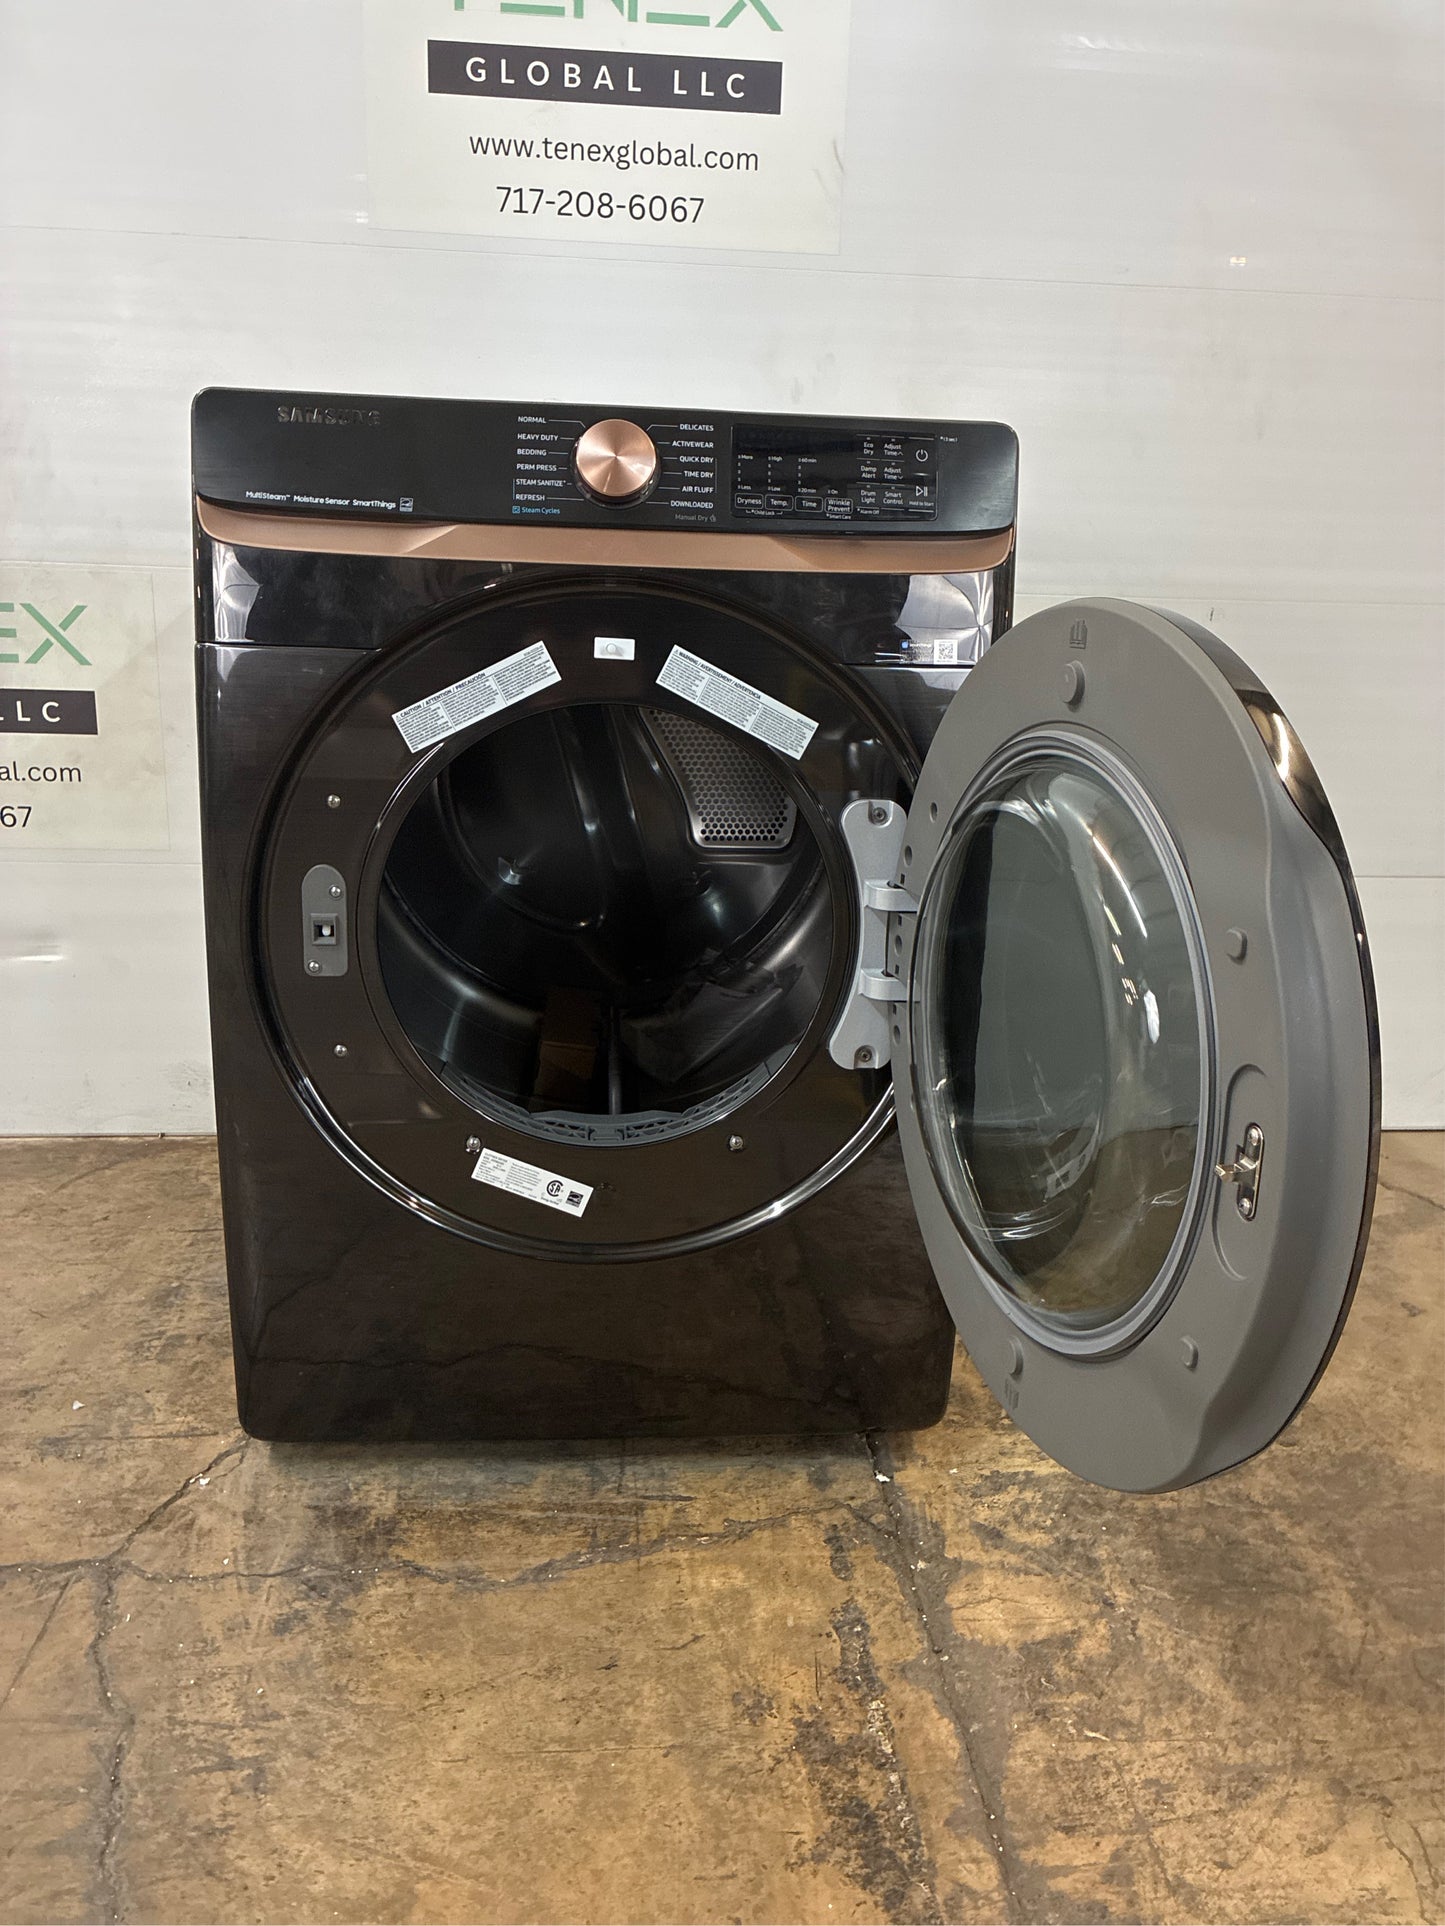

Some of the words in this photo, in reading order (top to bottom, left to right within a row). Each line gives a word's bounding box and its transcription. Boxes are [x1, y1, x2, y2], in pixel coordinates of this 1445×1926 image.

[465, 56, 642, 93] GLOBAL
[672, 69, 746, 99] LLC
[469, 136, 759, 171] www.tenexglobal.com
[496, 186, 705, 223] 717-208-6067
[672, 440, 714, 448] ACTIVEWEAR
[516, 448, 547, 456] BEDDING
[516, 463, 536, 471] PERM
[515, 478, 537, 486] STEAM
[293, 495, 325, 504] Moisture
[325, 497, 350, 505] Sensor
[352, 500, 396, 510] SmartThings
[670, 501, 714, 509] DOWNLOADED
[737, 497, 762, 505] Dryness
[802, 500, 817, 508] Time
[541, 507, 561, 515] Cycles
[400, 704, 421, 717] CAUTION
